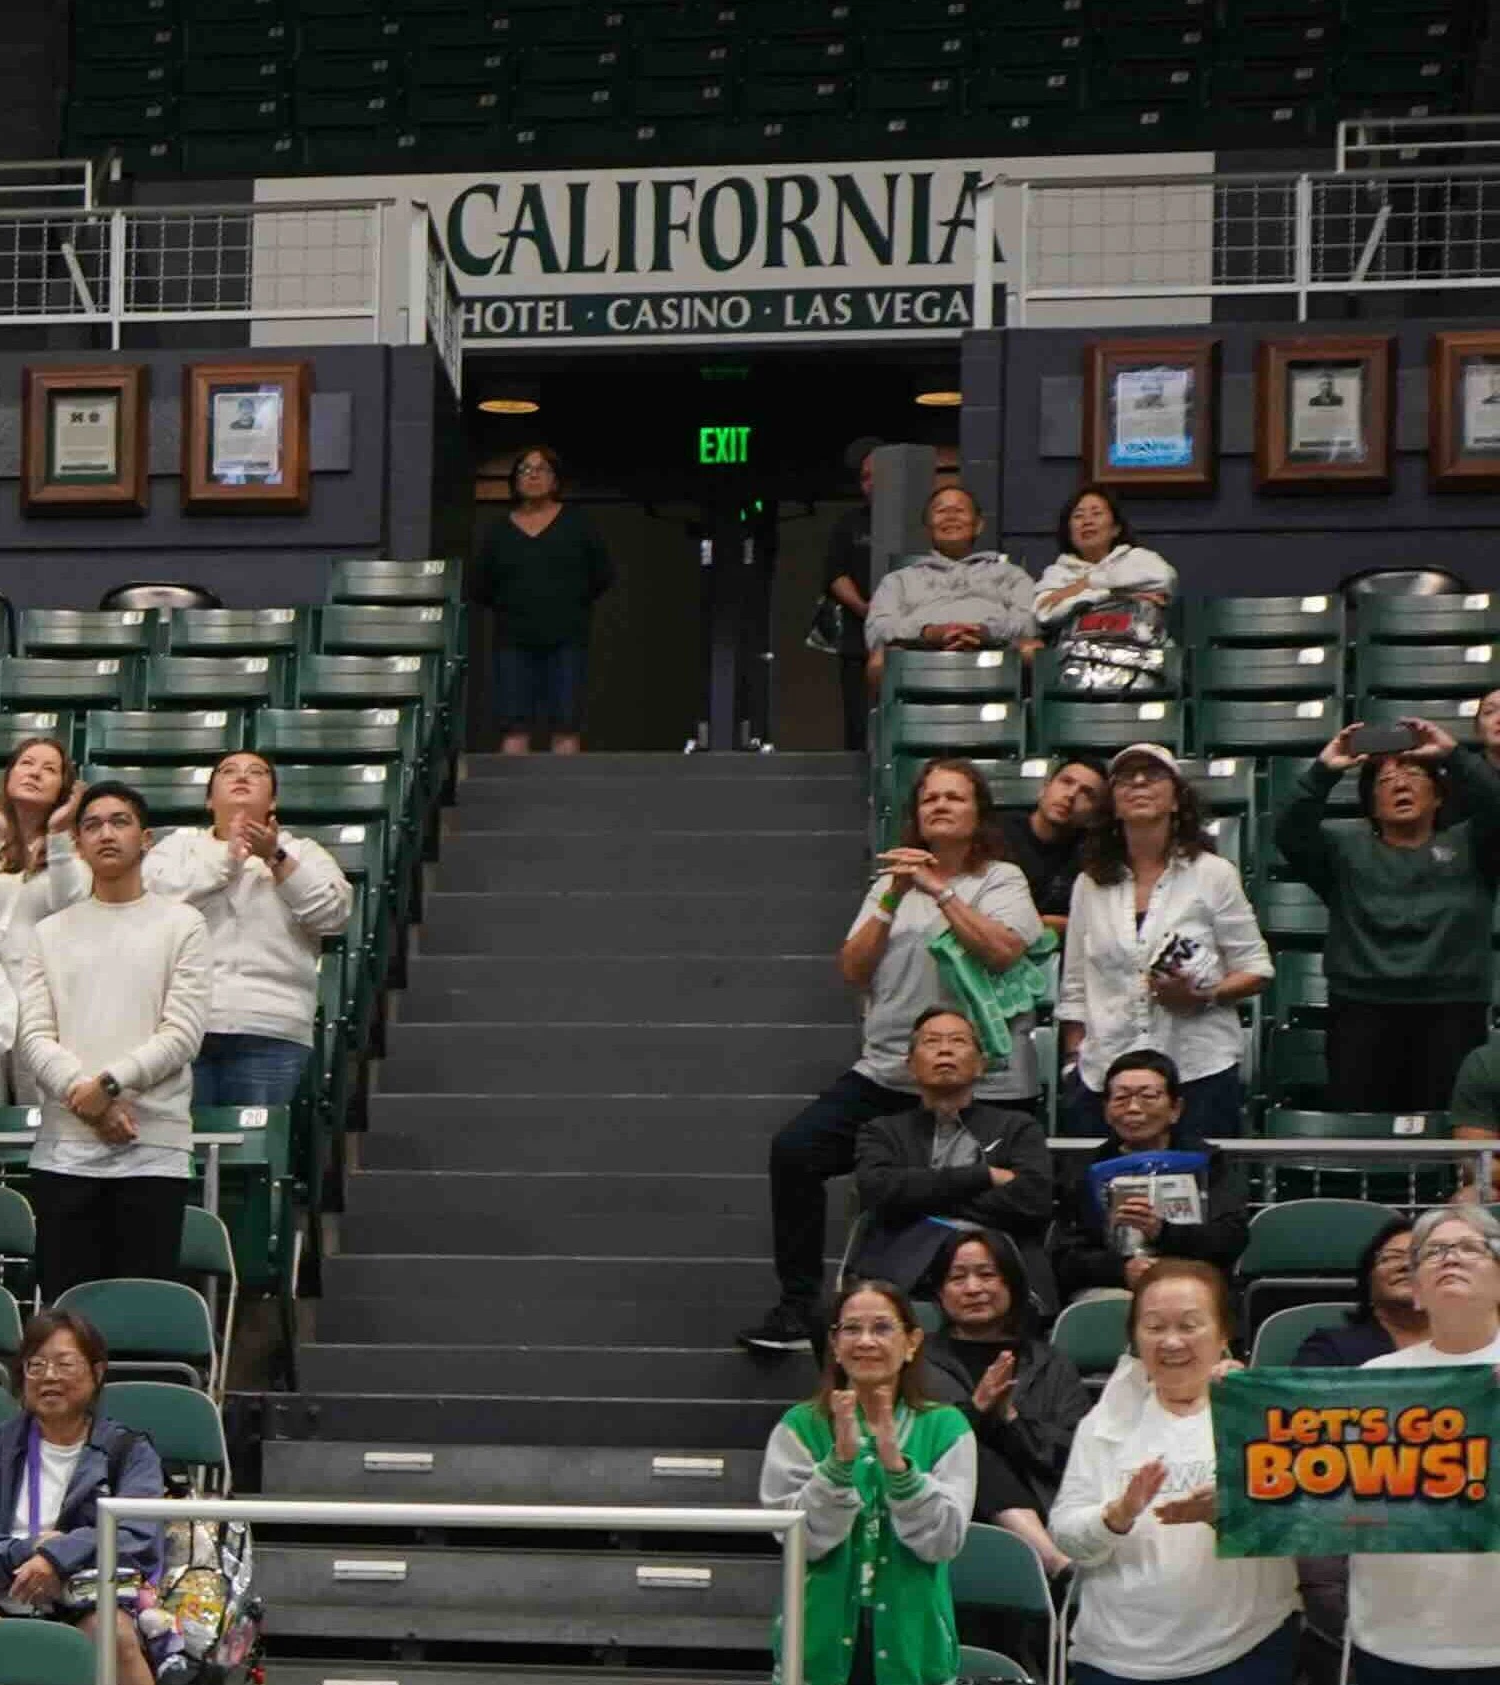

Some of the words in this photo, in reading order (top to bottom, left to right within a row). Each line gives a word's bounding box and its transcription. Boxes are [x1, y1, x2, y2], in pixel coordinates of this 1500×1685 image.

[446, 169, 1007, 277] CALIFORNIA
[460, 299, 573, 335] HOTEL
[605, 294, 752, 331] CASINO
[784, 292, 852, 327] LAS
[865, 289, 972, 325] VEGA
[699, 426, 751, 464] EXIT
[1396, 1406, 1467, 1445] GO
[1244, 1438, 1491, 1504] BOWS!
